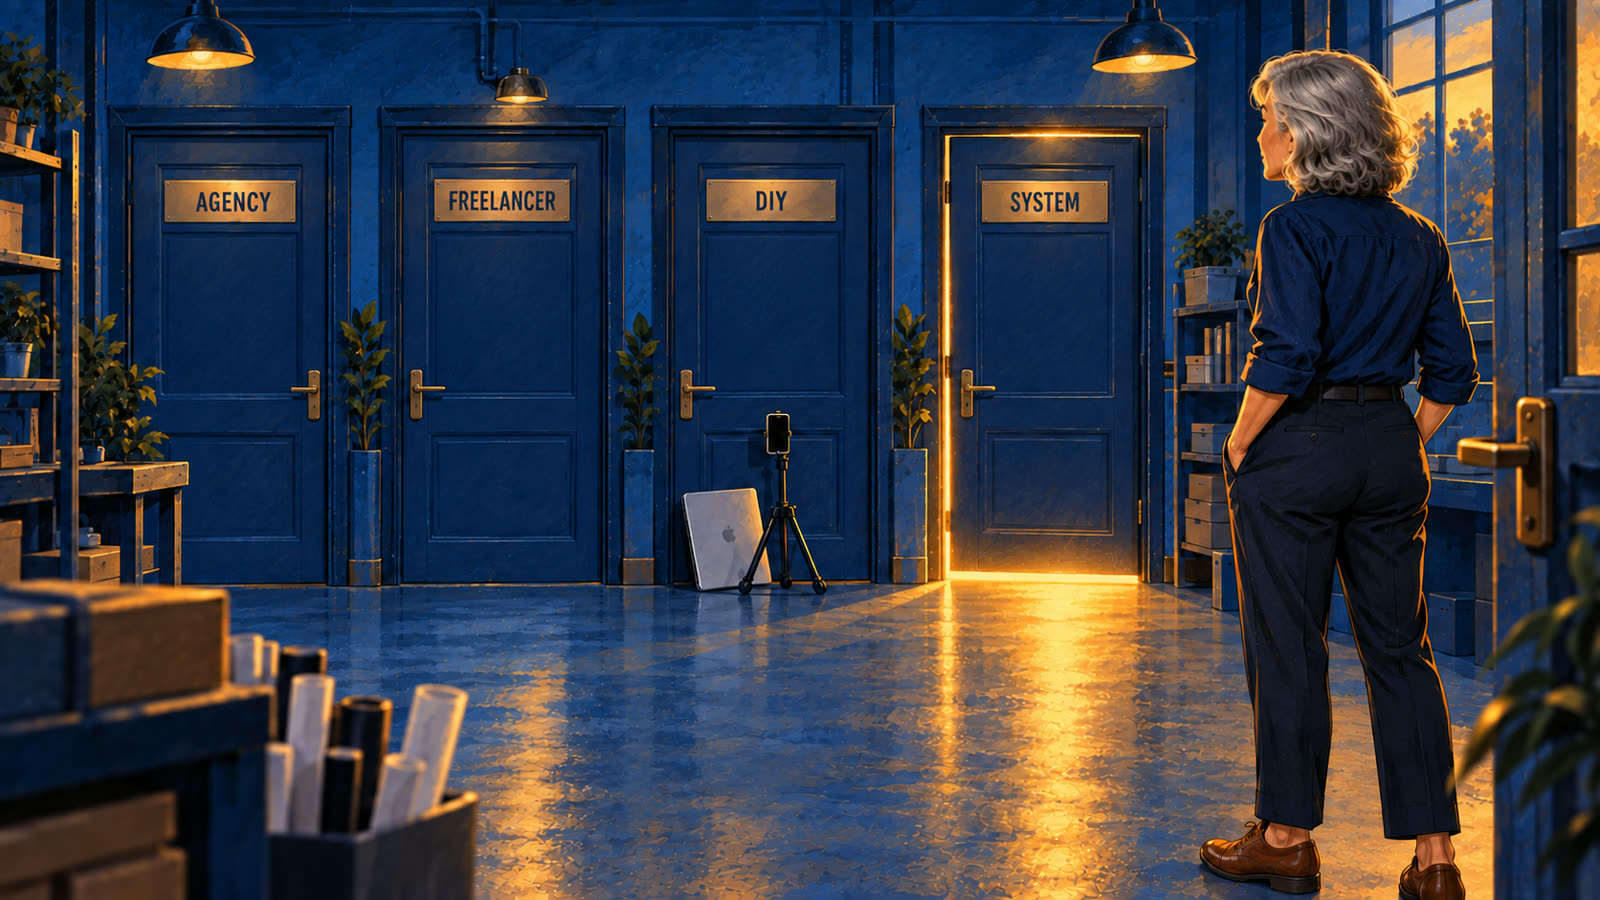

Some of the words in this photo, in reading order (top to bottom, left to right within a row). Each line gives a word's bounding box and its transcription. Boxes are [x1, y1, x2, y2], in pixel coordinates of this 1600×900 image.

[195, 191, 271, 212] AGENCY
[448, 190, 556, 211] FREELANCER
[755, 190, 788, 211] DIY
[1009, 191, 1080, 212] SYSTEM
